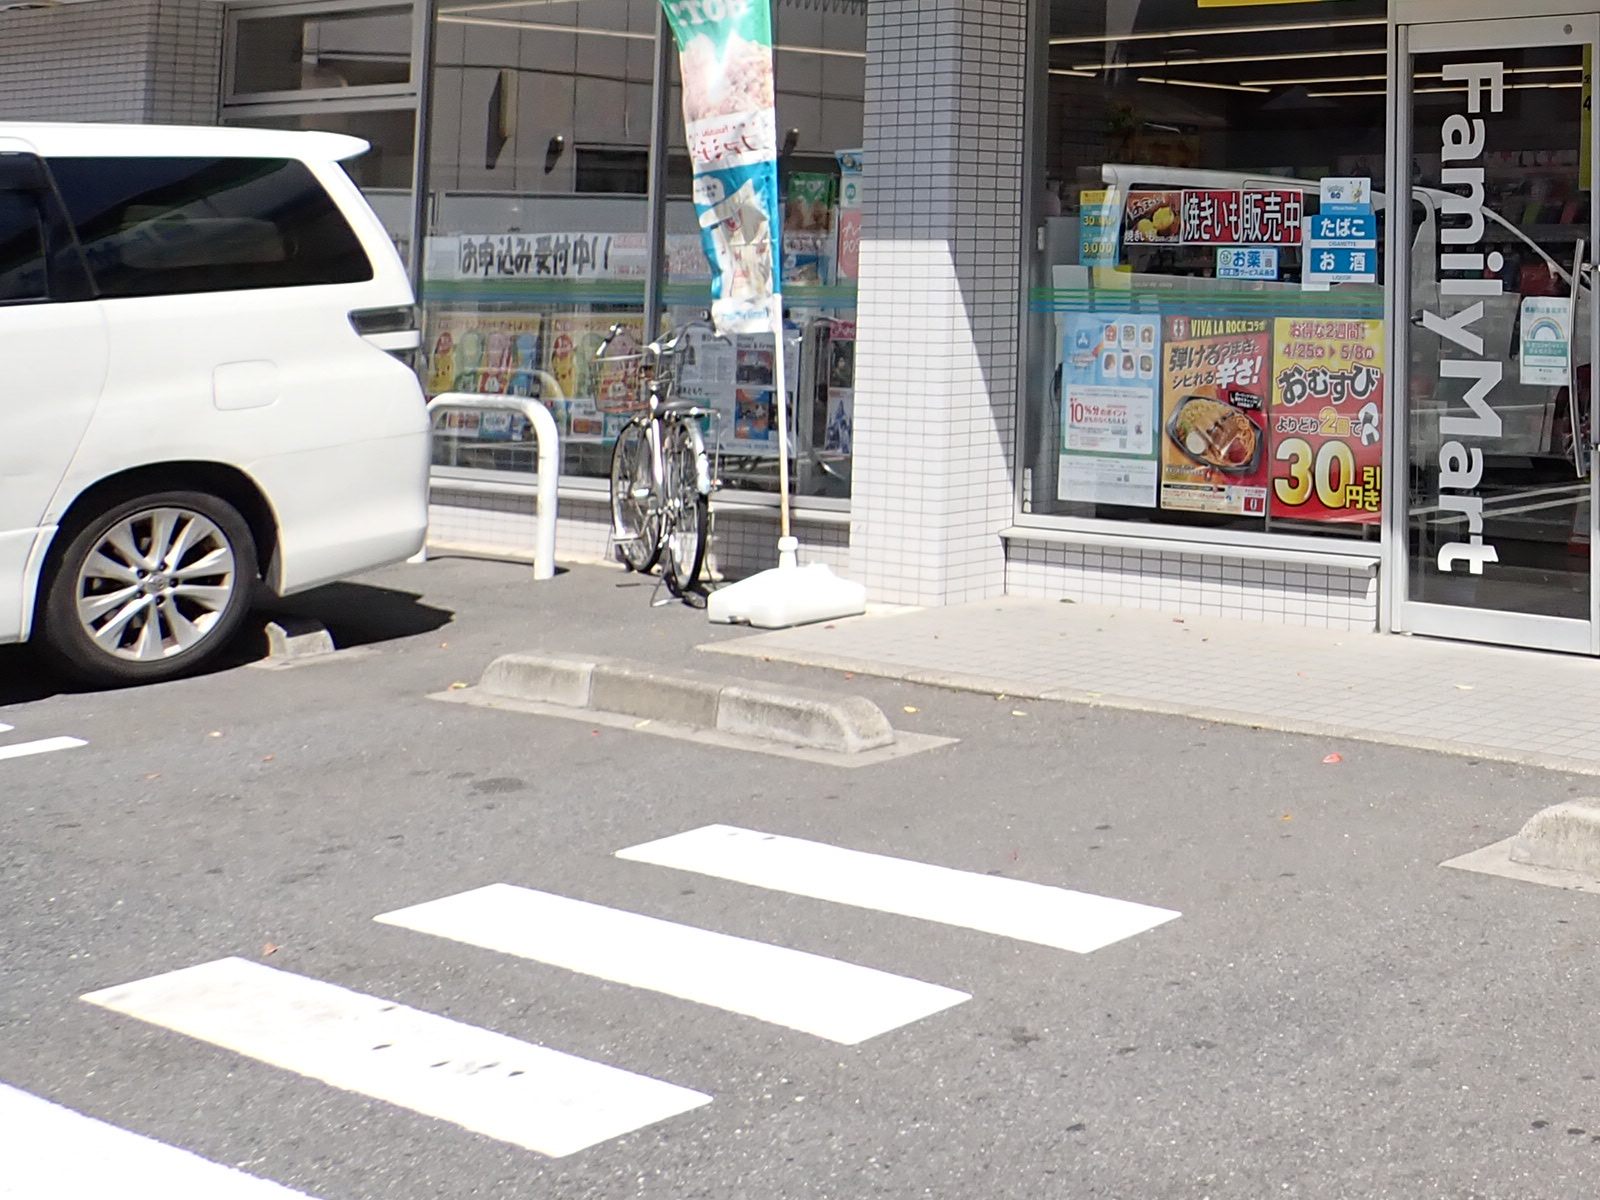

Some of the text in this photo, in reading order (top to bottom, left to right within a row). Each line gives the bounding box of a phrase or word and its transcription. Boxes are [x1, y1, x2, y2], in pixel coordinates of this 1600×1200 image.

[1321, 218, 1365, 237] たばこ
[1320, 252, 1366, 271] お酒
[1191, 319, 1212, 337] VIVA
[1214, 319, 1224, 335] LA
[1422, 62, 1503, 575] FamilyMart
[1290, 321, 1366, 341] お得な2週間!
[1277, 362, 1380, 406] おむすび
[1276, 406, 1362, 436] よりどり2個で
